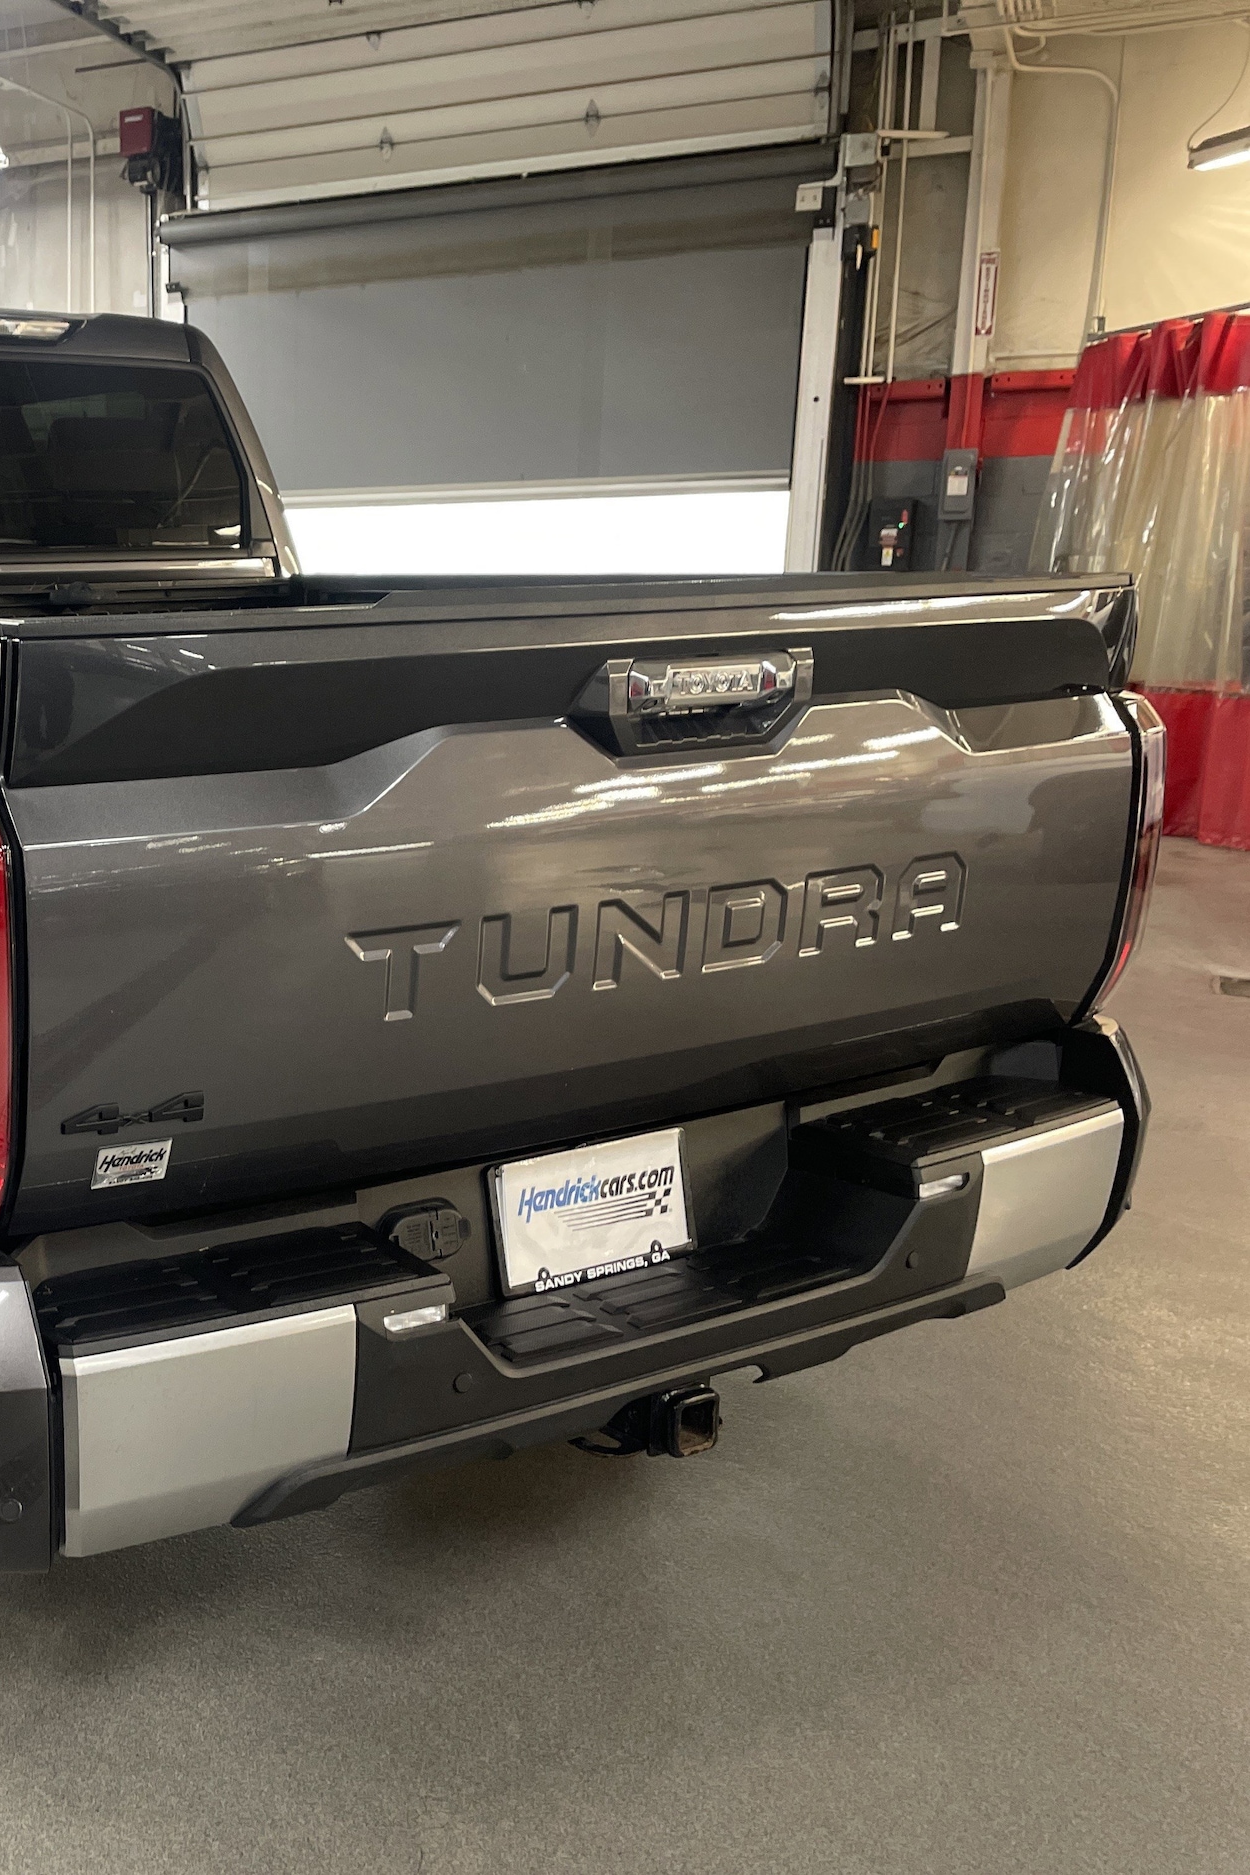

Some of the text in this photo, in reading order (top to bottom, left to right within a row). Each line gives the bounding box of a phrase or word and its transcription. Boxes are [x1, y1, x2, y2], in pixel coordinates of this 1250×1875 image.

[676, 669, 754, 695] TOYOTA
[344, 850, 969, 1022] TUNDRA
[99, 1148, 168, 1173] Hendrick
[517, 1165, 675, 1224] Hendrickcars.com
[535, 1250, 671, 1293] SANDY SPRINGS, GA
